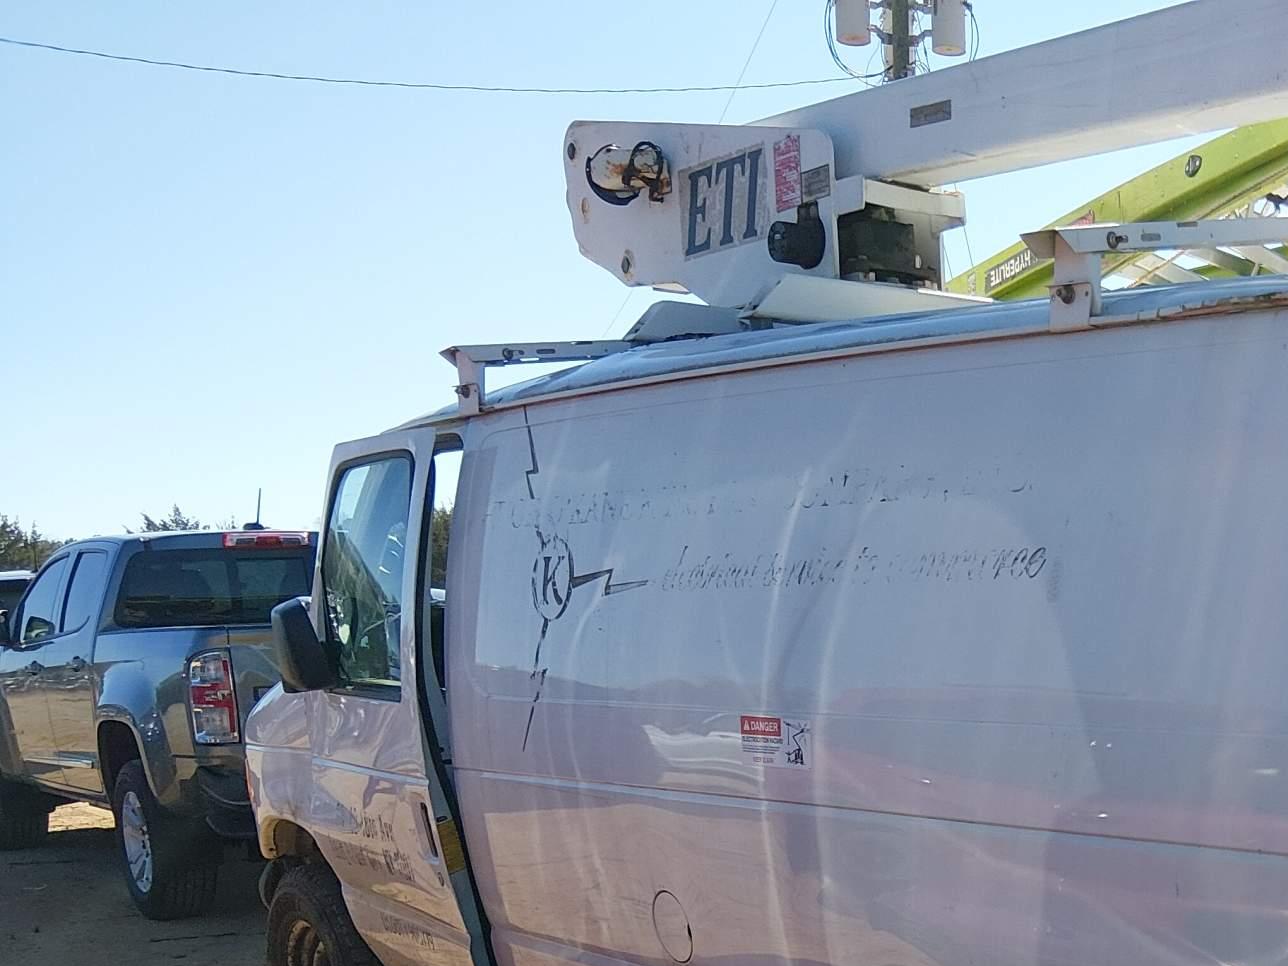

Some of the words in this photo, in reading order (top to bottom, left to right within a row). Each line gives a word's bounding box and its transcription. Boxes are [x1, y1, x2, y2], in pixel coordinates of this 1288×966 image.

[686, 149, 762, 256] ETI
[990, 249, 1031, 286] HYPERLITE
[541, 555, 565, 604] K
[750, 720, 778, 732] DANGER
